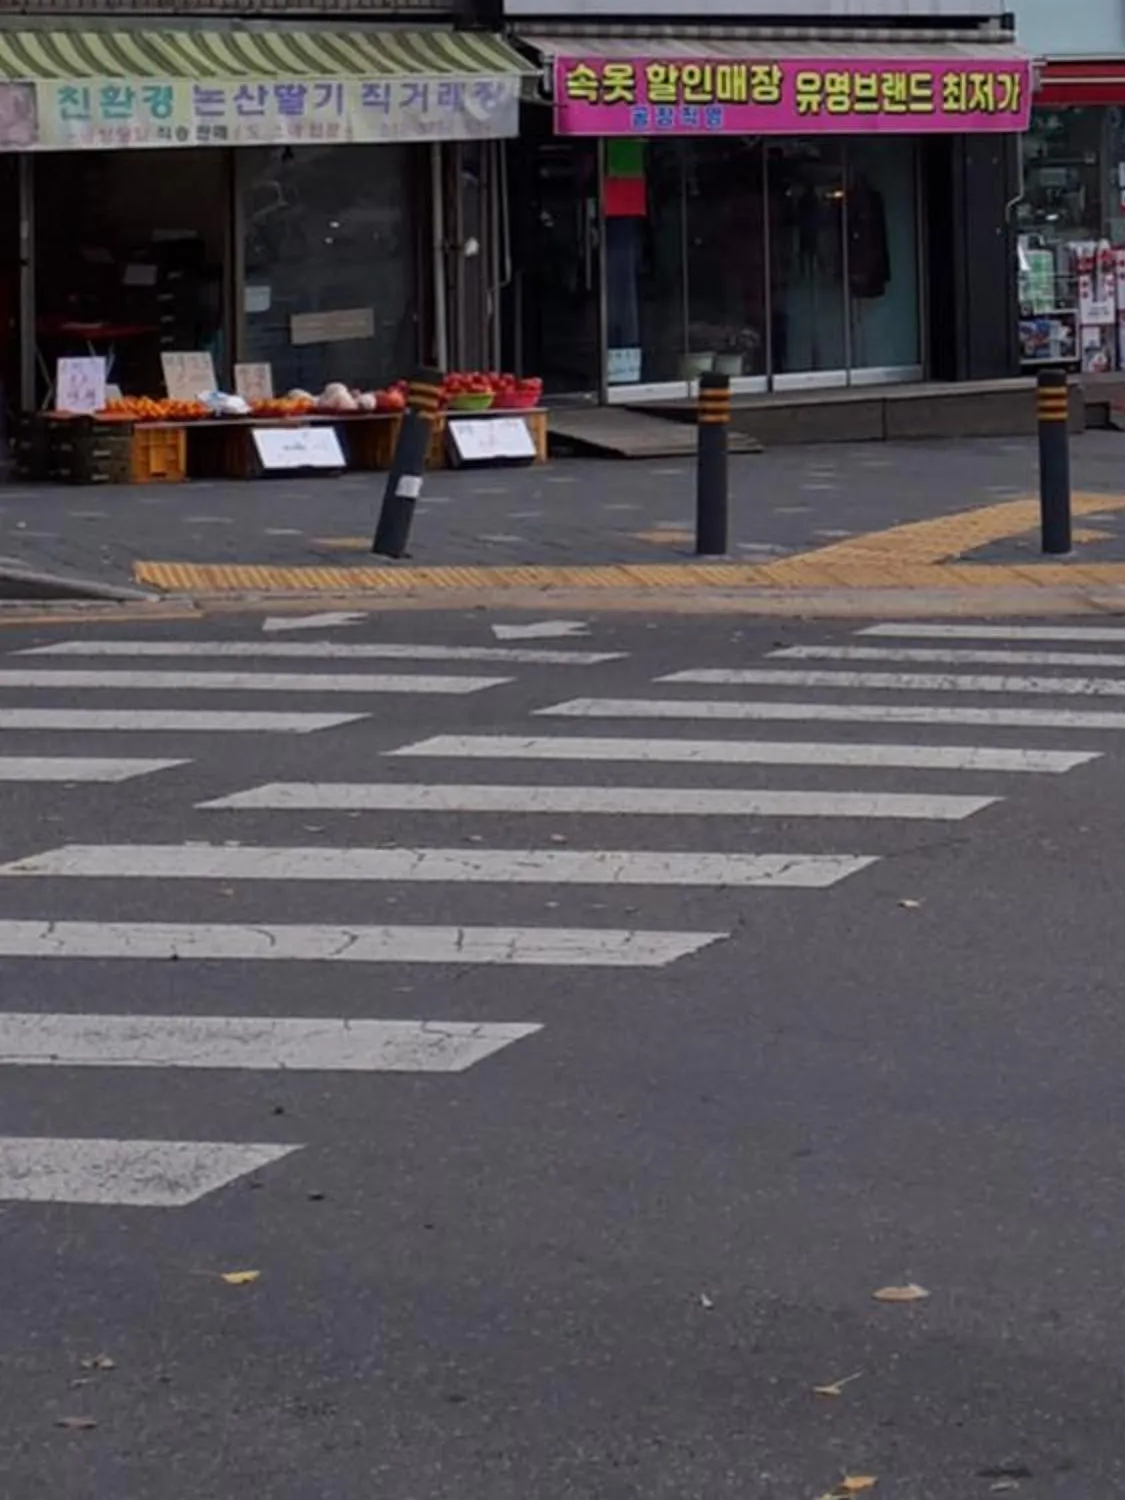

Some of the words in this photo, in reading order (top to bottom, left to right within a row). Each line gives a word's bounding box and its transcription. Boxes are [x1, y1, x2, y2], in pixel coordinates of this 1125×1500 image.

[57, 84, 174, 120] 친환경
[193, 82, 343, 117] 논산딸기
[566, 63, 636, 104] 속옷
[646, 63, 783, 103] 할인매장
[796, 71, 934, 113] 유명브랜드
[943, 71, 1020, 113] 최저가
